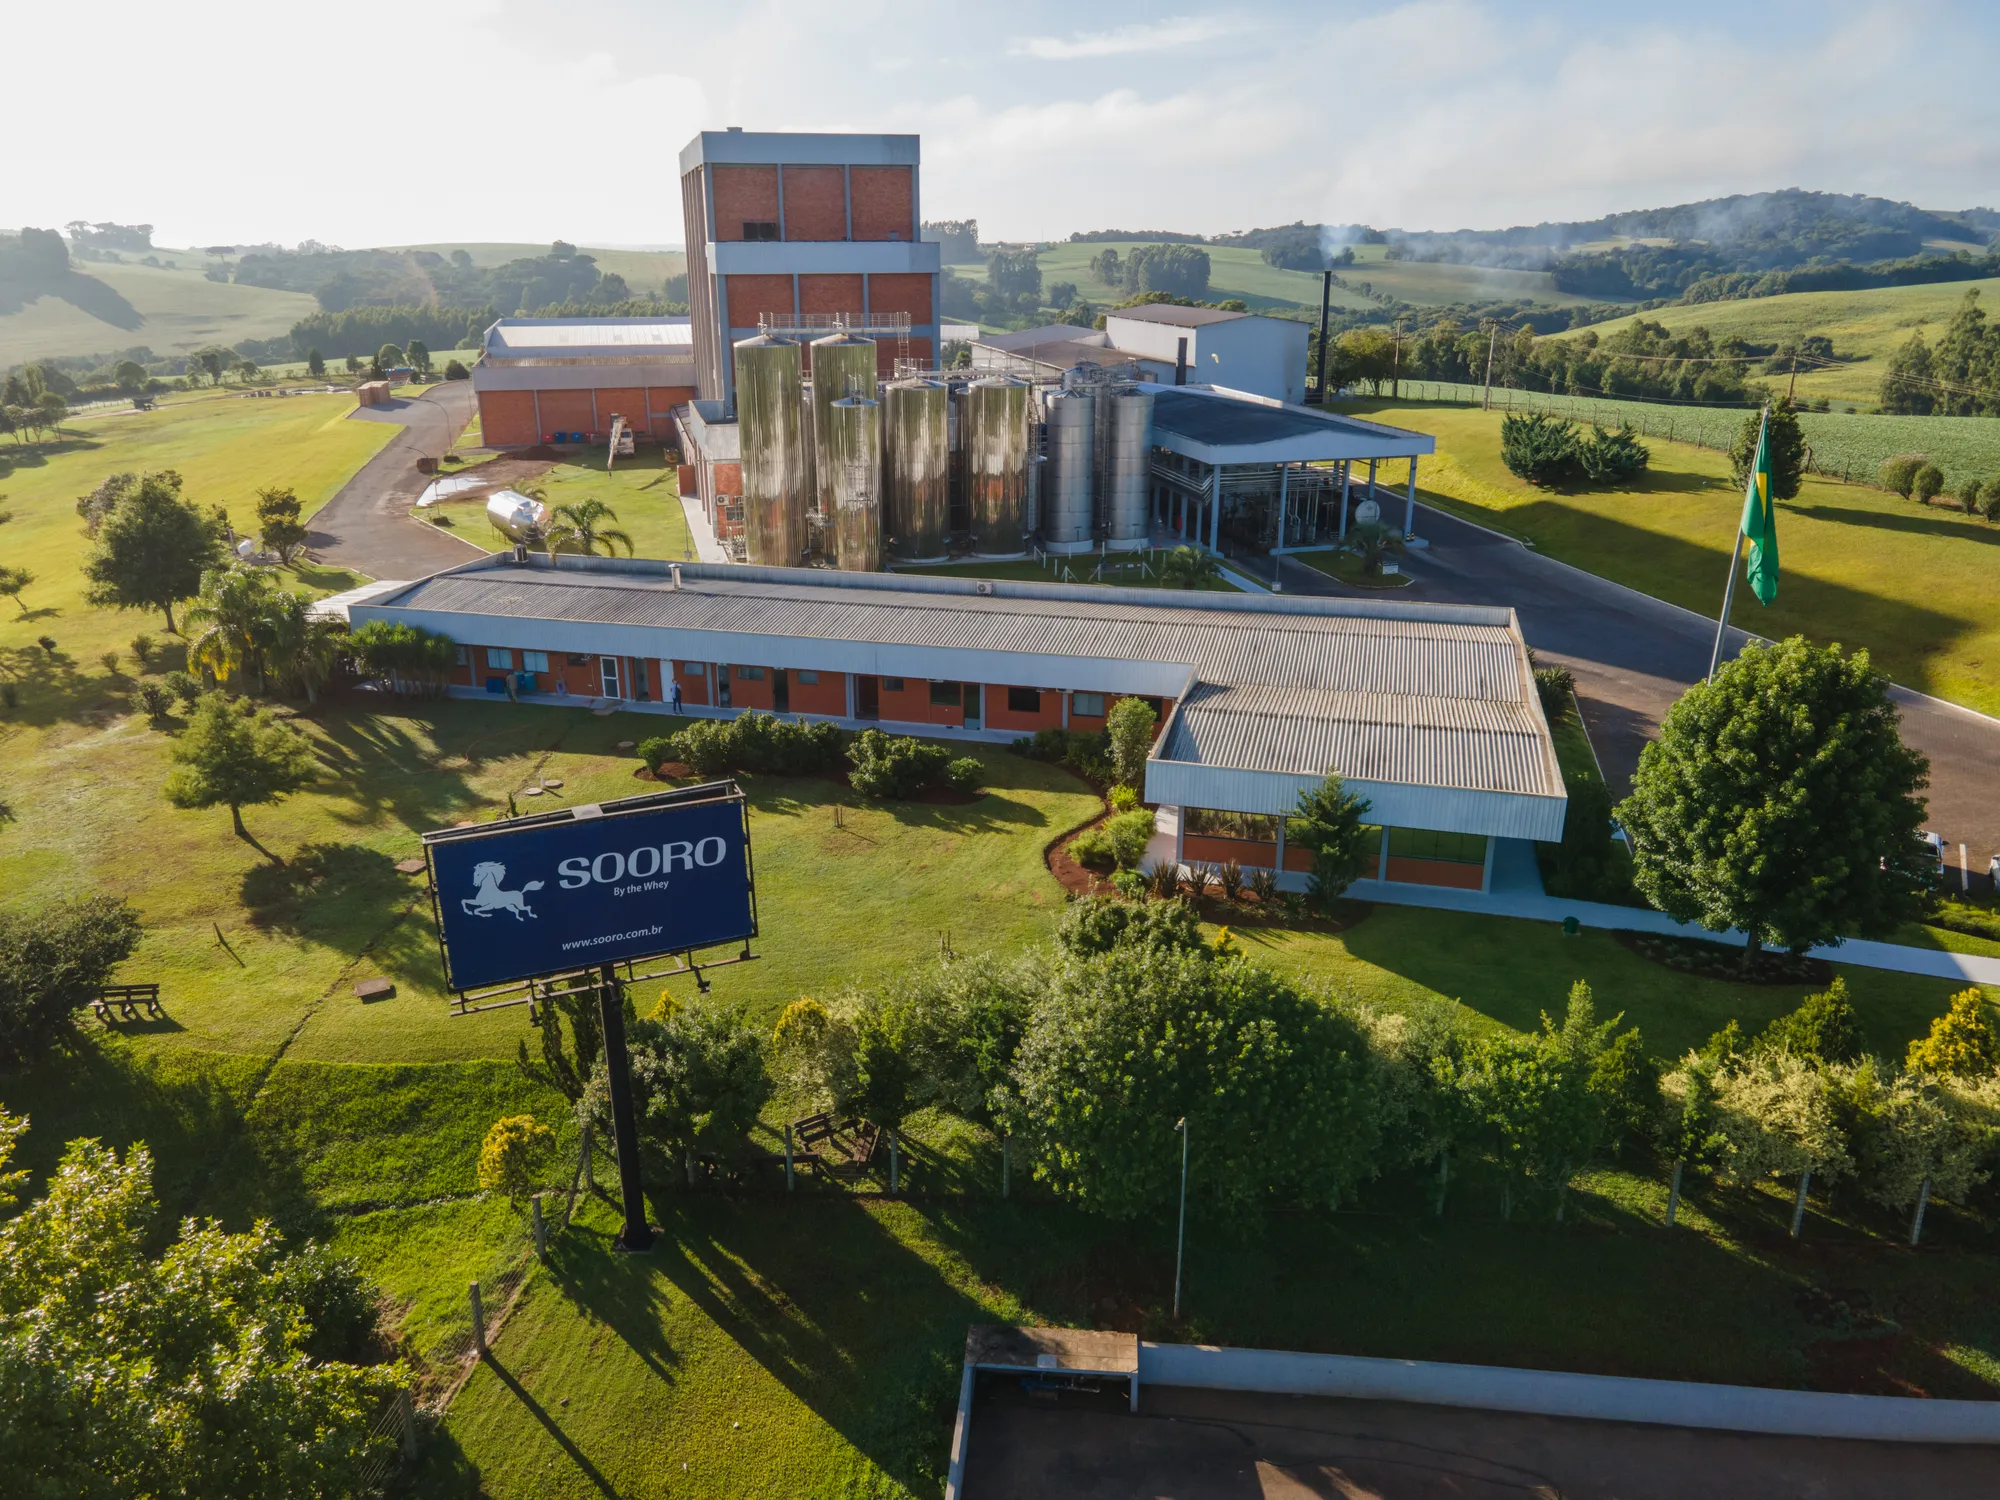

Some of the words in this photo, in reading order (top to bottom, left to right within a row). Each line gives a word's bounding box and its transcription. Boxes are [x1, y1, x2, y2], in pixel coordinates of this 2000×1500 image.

[557, 836, 727, 889] SOORO
[613, 886, 626, 897] By
[626, 883, 642, 894] the
[643, 880, 669, 893] Whey
[562, 924, 663, 951] www.sooro.com.br
